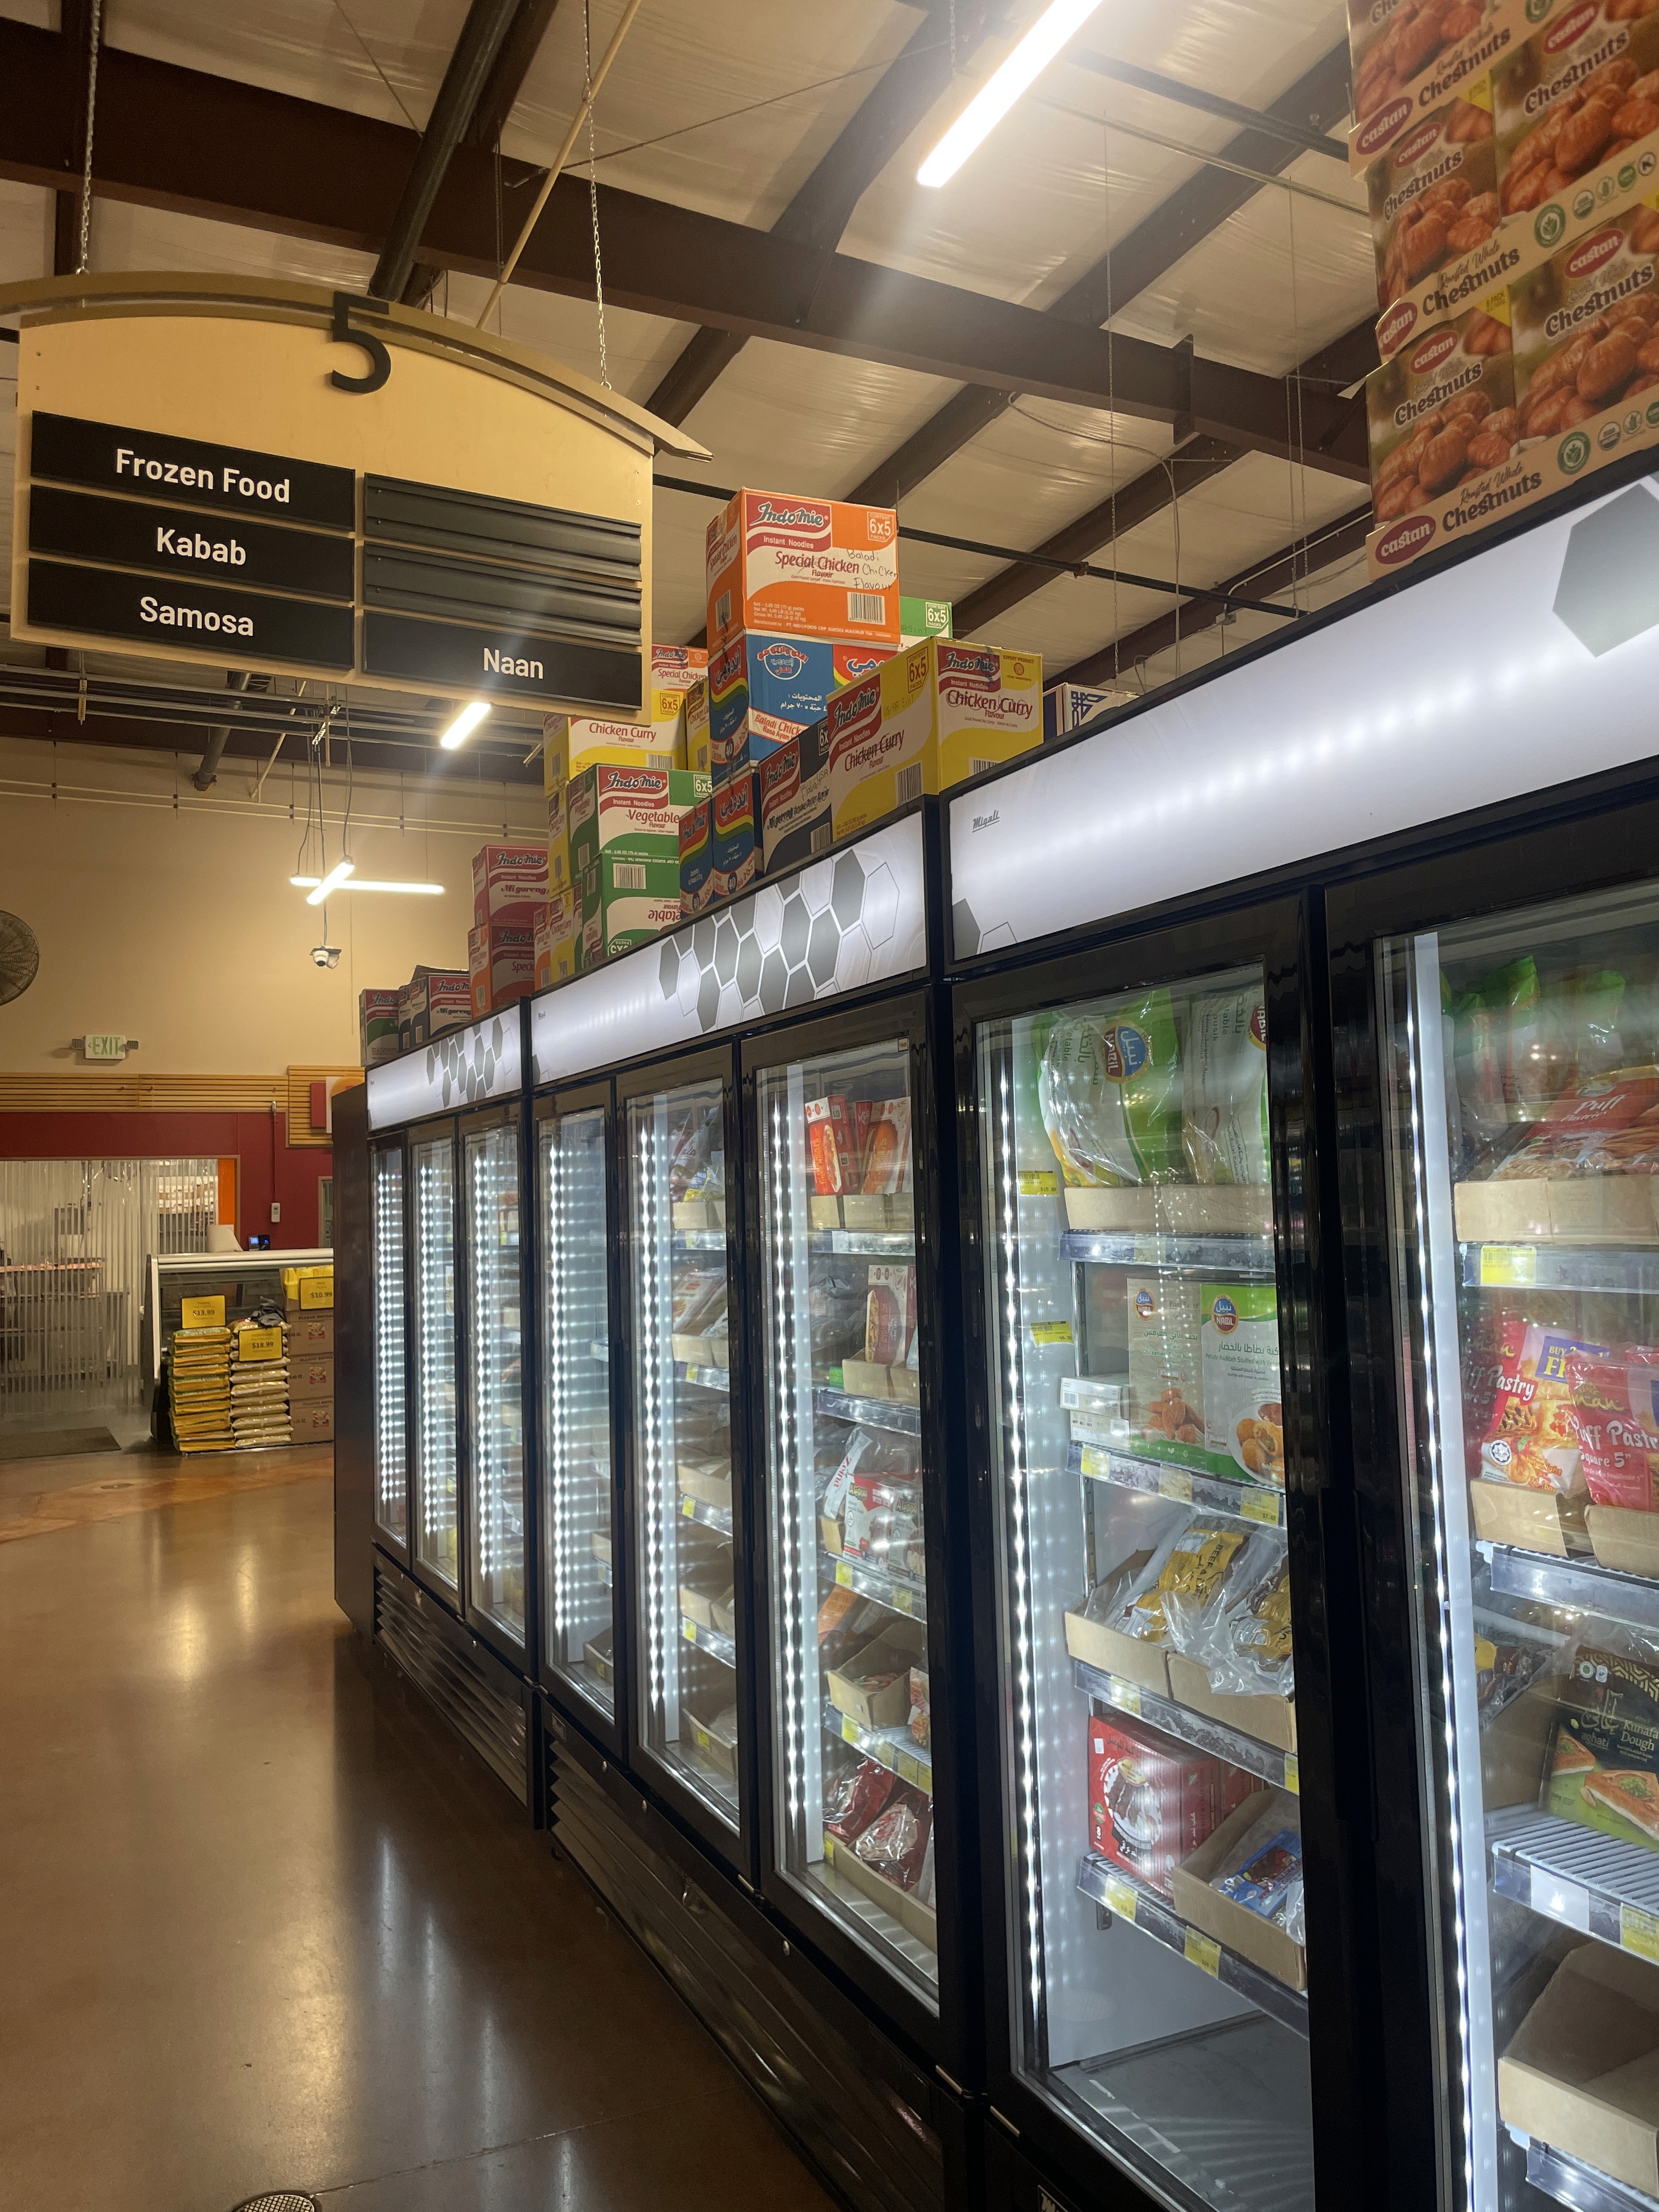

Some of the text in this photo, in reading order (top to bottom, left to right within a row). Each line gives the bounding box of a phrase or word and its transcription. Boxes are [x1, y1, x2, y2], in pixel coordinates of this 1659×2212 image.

[1419, 28, 1510, 107] Chestnuts
[1526, 32, 1626, 114] Chestnuts
[1361, 104, 1408, 148] castan
[1384, 151, 1462, 220] Chestnuts
[1570, 236, 1618, 272] castan
[1423, 249, 1520, 316] Chestnuts
[1545, 265, 1653, 337] Chestnuts
[331, 291, 392, 393] 5
[1414, 337, 1453, 369] castan
[1395, 364, 1481, 426] Chestnuts
[115, 448, 291, 503] Frozen Food
[1442, 472, 1542, 532] Chestnuts
[870, 518, 891, 536] 6x5
[156, 526, 247, 566] Kabab
[763, 535, 814, 549] Instant Noodles
[1380, 523, 1431, 557] castan
[775, 551, 860, 574] Special Chicken
[812, 569, 834, 578] Flavour
[854, 577, 892, 591] Flavour
[139, 595, 255, 637] Samosa
[928, 608, 946, 623] 6x5
[482, 647, 544, 680] Naan
[658, 668, 706, 681] Special Chicken
[909, 656, 927, 682] 6x5
[662, 698, 678, 711] 6x5
[947, 690, 1033, 720] Chicken Curry
[985, 710, 1005, 720] Flavour
[589, 723, 657, 743] Chicken Curry
[754, 714, 805, 736] Baladi Chick
[763, 725, 791, 741] Rasa Ayam
[819, 729, 829, 744] 6x
[838, 729, 871, 752] Instant Noodles
[845, 729, 905, 772] Chicken Curry
[695, 779, 713, 793] 6x5
[628, 809, 680, 825] Vegetable
[515, 886, 548, 896] goreng
[648, 910, 681, 922] etable
[92, 1036, 120, 1055] EXIT
[1573, 1092, 1631, 1114] Puff
[1216, 1301, 1232, 1313] نبيل
[1218, 1340, 1242, 1352] بالخضار
[1549, 1346, 1566, 1356] BUY
[1237, 1356, 1255, 1364] Stuffed
[1487, 1365, 1535, 1401] Pastry
[1578, 1445, 1610, 1467] Square
[1207, 1544, 1224, 1568] BEEF
[1581, 1731, 1610, 1749] aghati
[1623, 1720, 1659, 1739] Kunafa
[1620, 1731, 1655, 1751] Dough
